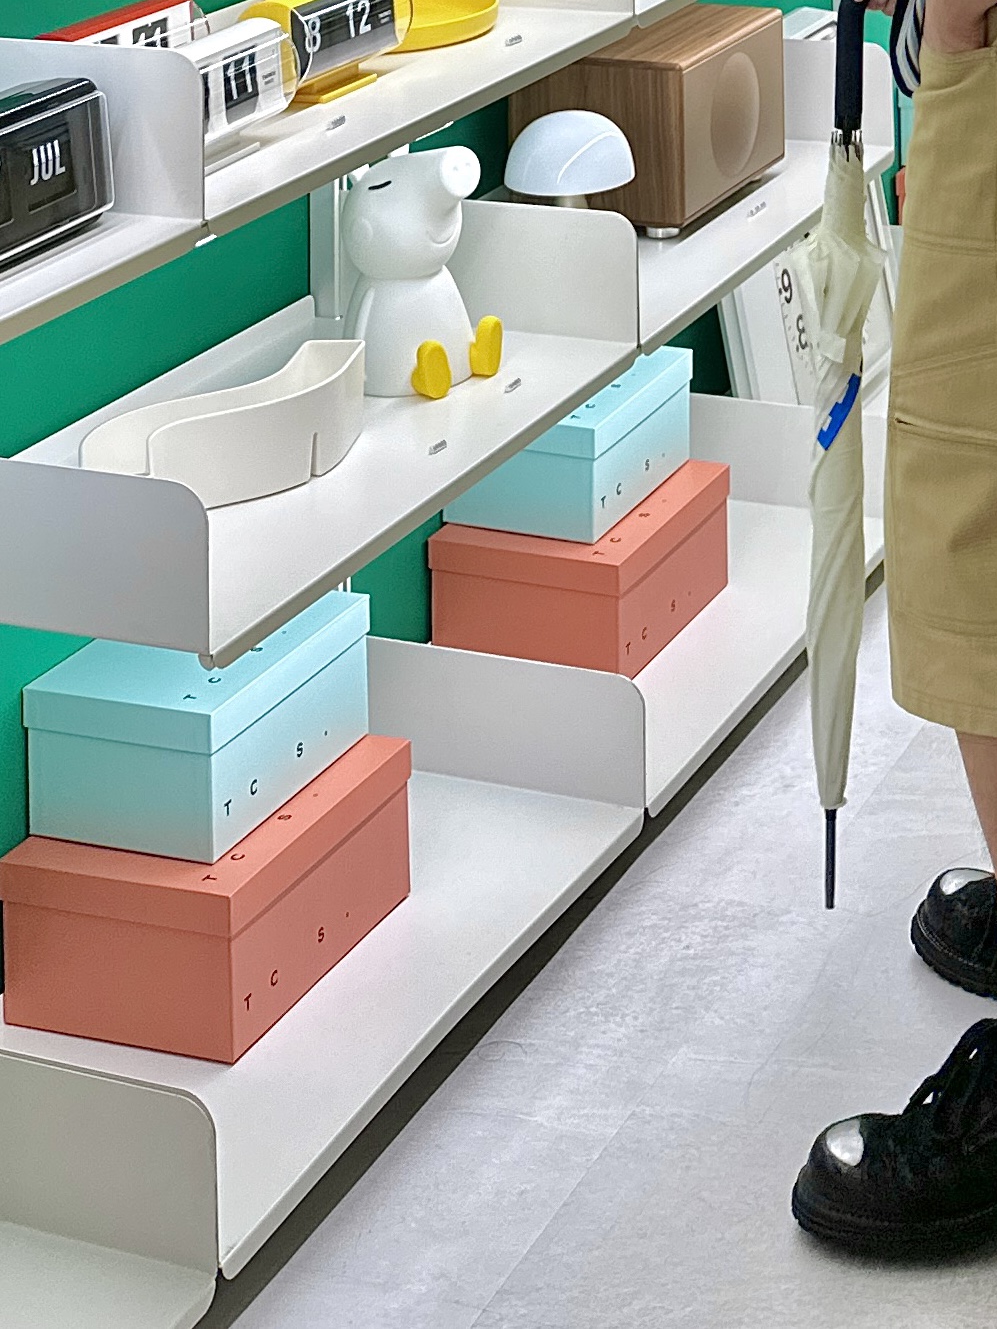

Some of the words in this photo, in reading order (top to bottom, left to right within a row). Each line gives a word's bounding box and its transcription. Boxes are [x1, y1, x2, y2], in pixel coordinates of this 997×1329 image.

[226, 55, 254, 101] 11
[29, 138, 66, 186] JUL
[224, 799, 232, 816] T
[250, 779, 258, 796] C
